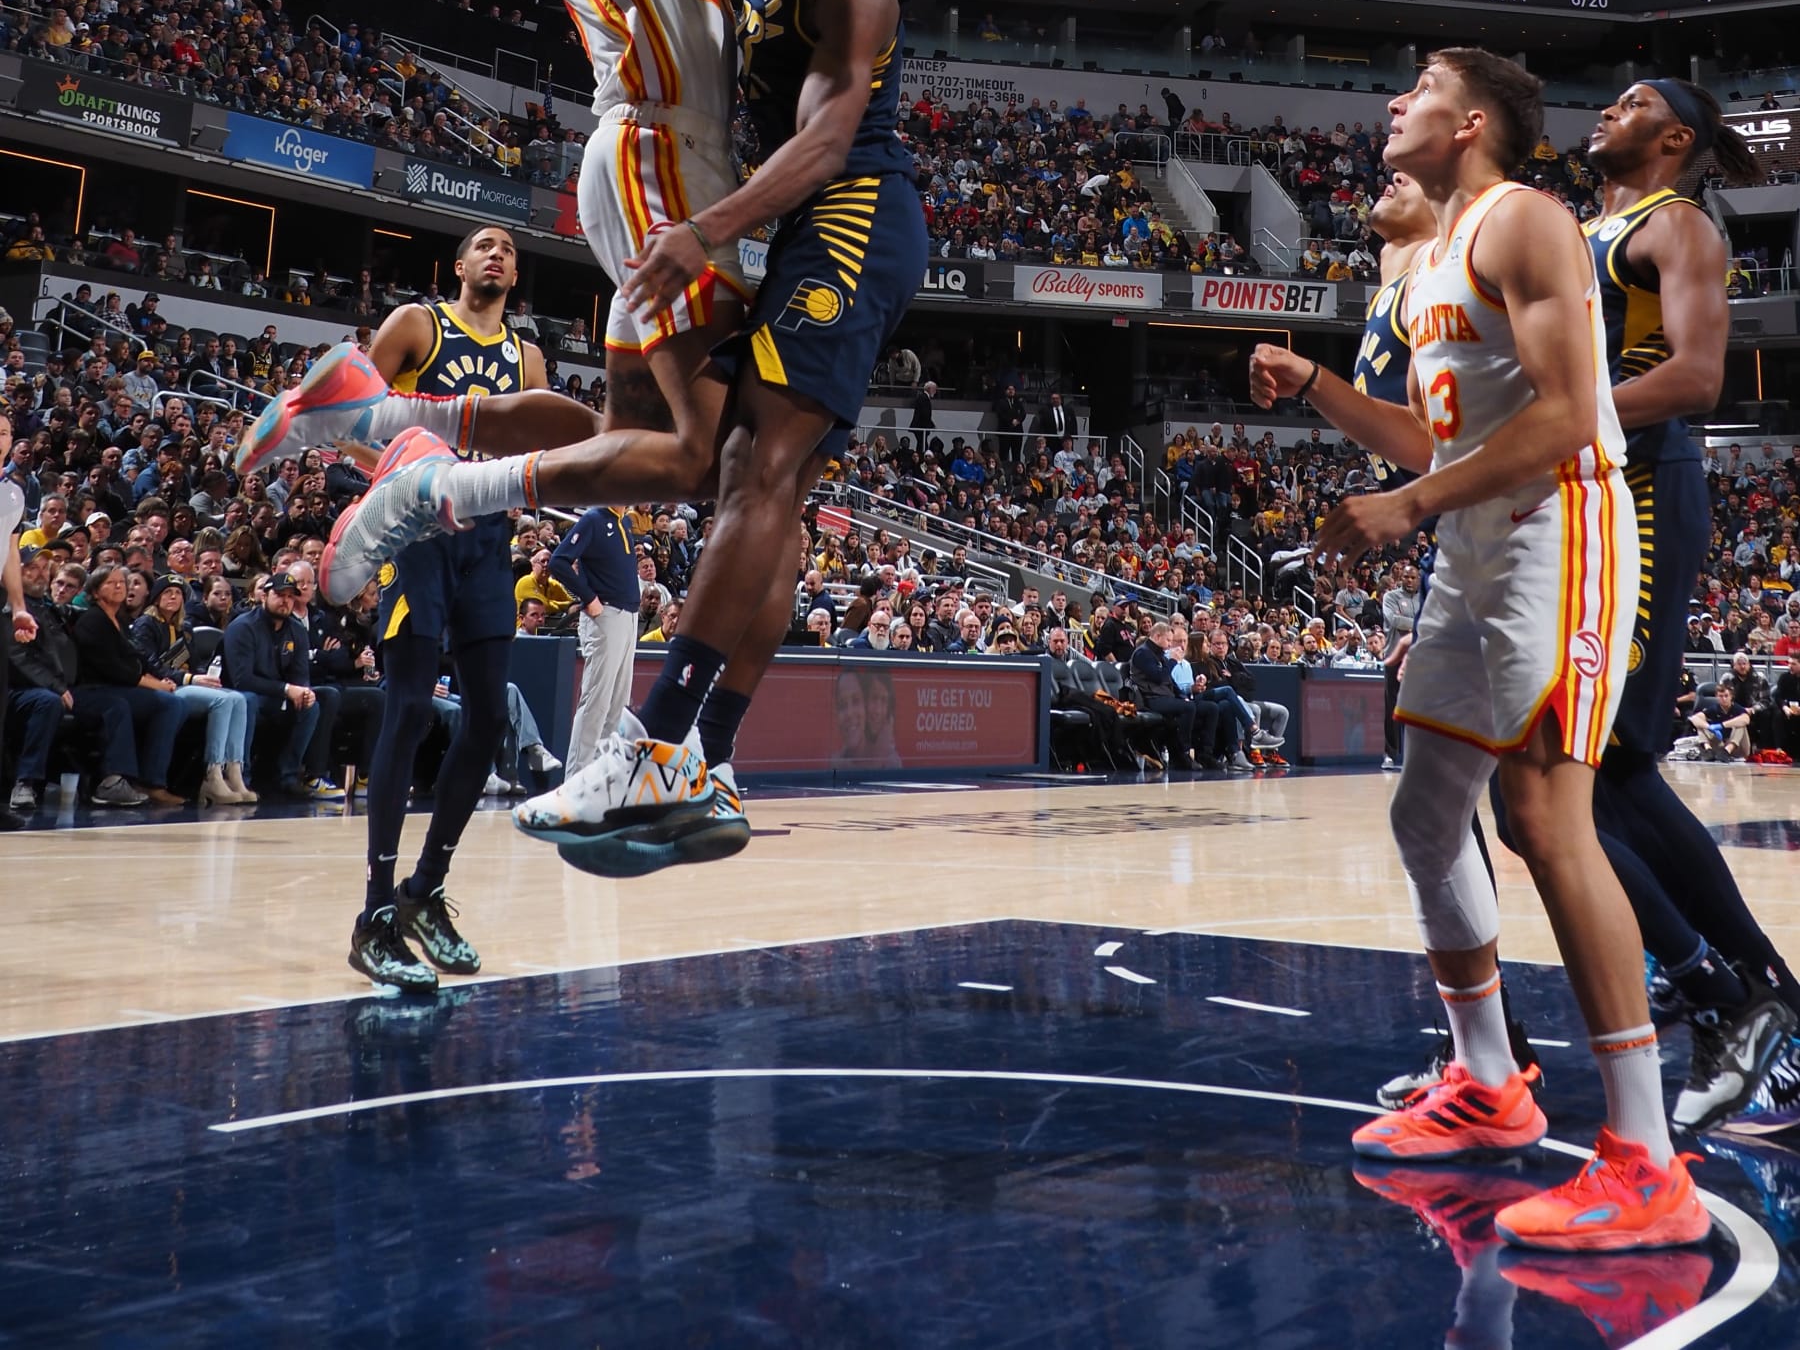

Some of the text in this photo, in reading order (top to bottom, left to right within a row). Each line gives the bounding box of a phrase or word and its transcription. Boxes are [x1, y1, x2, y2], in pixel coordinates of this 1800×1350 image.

[920, 74, 935, 85] TO
[937, 75, 1017, 92] 707-TIMEOUT.
[966, 89, 1025, 103] 846-3688
[1144, 83, 1149, 96] 7
[58, 89, 161, 124] DRAFTKINGS
[82, 111, 159, 138] SPORTSBOOK
[1731, 119, 1792, 136] XUS
[274, 128, 329, 173] Kroger
[431, 172, 528, 210] Ruoff MORTGAGE
[42, 277, 49, 295] 6
[1032, 268, 1144, 303] Bally SPORTS
[1201, 281, 1328, 314] POINTSBET
[1410, 302, 1483, 351] TLANTA
[437, 355, 513, 392] INDIAN
[917, 689, 992, 708] WE GET YOU
[916, 712, 977, 732] COVERED.
